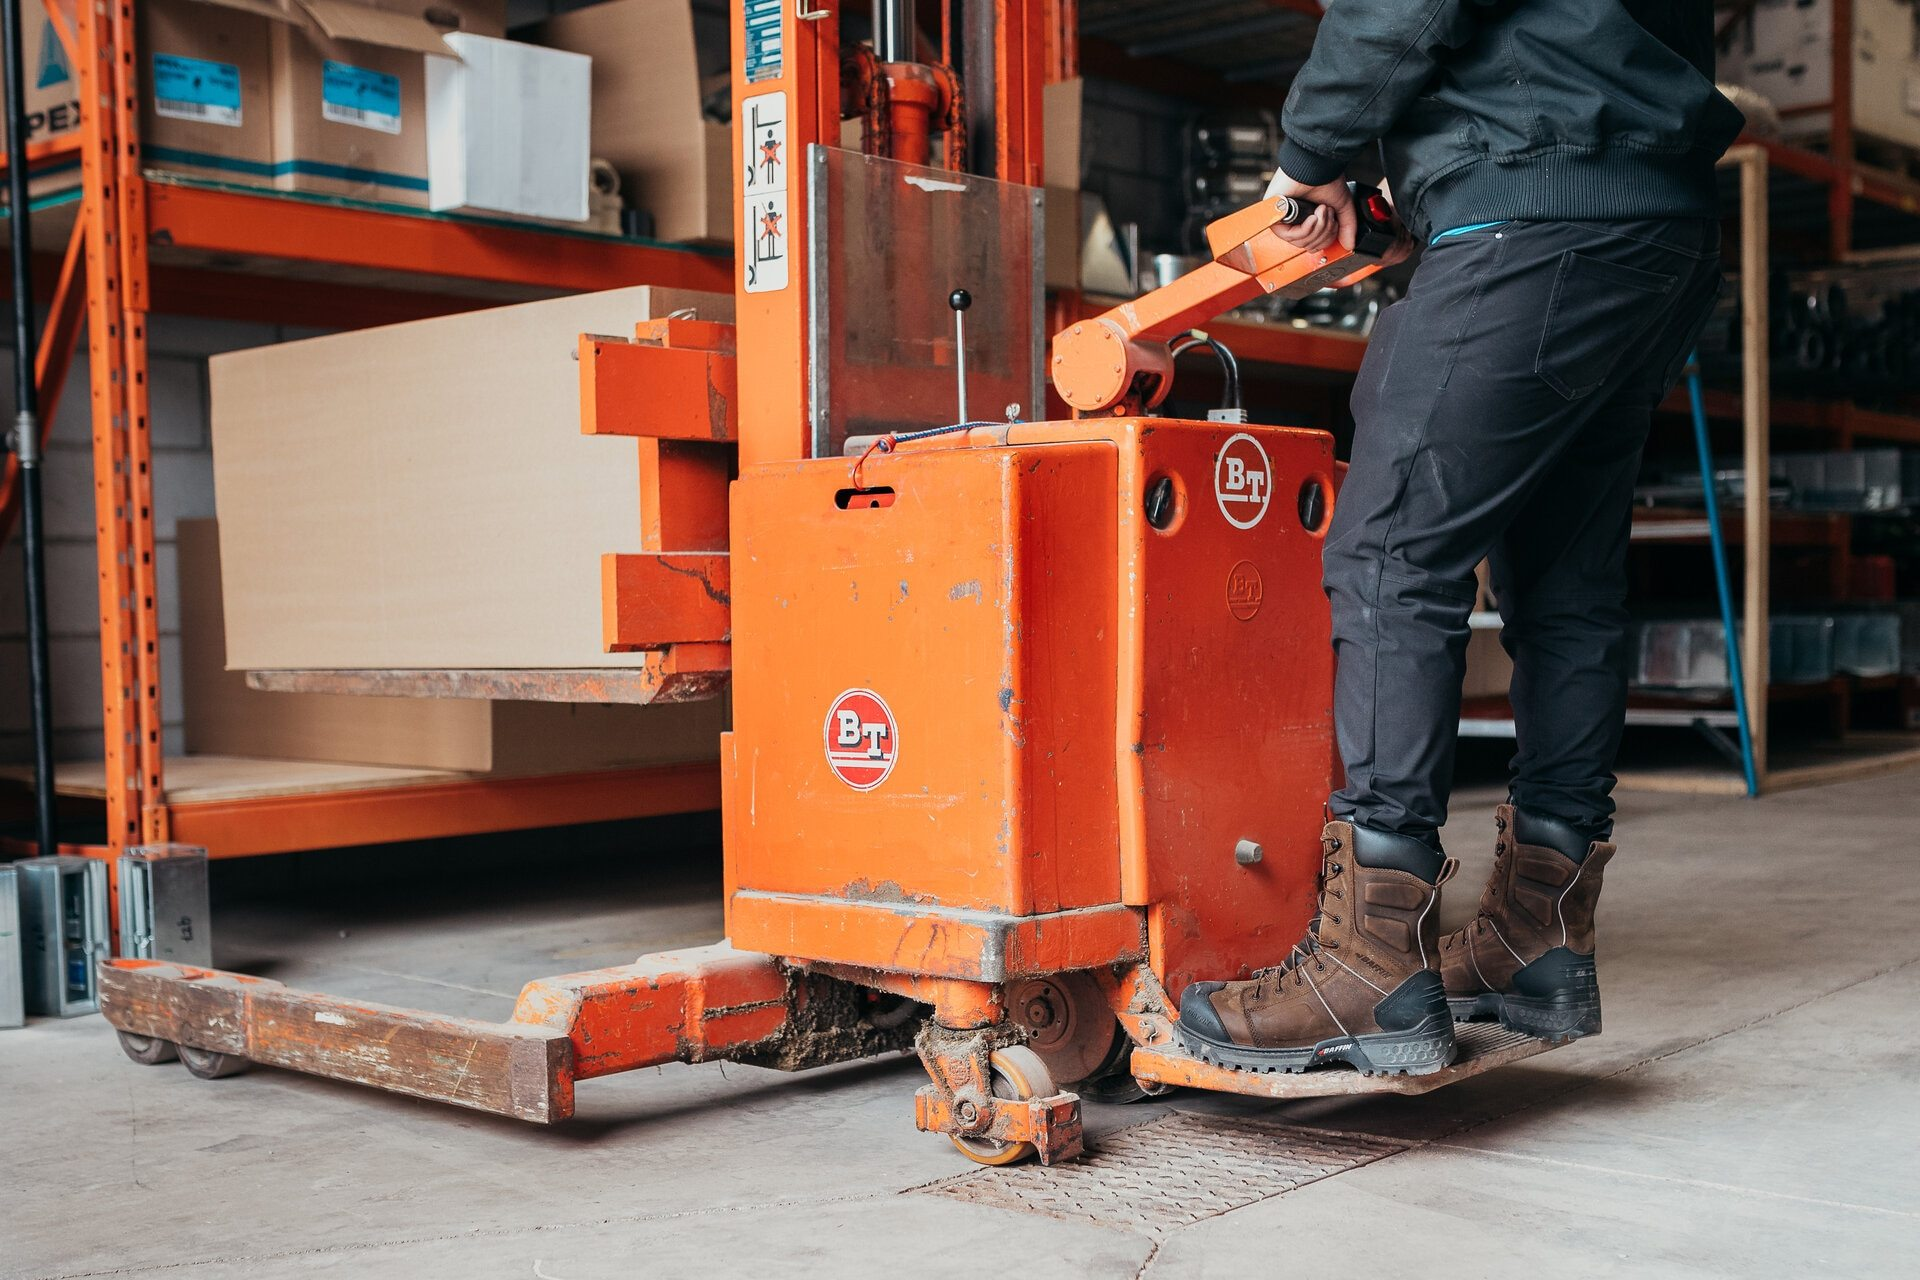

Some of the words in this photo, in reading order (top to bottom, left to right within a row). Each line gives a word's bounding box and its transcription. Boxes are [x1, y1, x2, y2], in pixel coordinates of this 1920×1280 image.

[1226, 457, 1264, 503] BT
[837, 709, 888, 760] BT
[1323, 1043, 1353, 1055] BAFFIN
